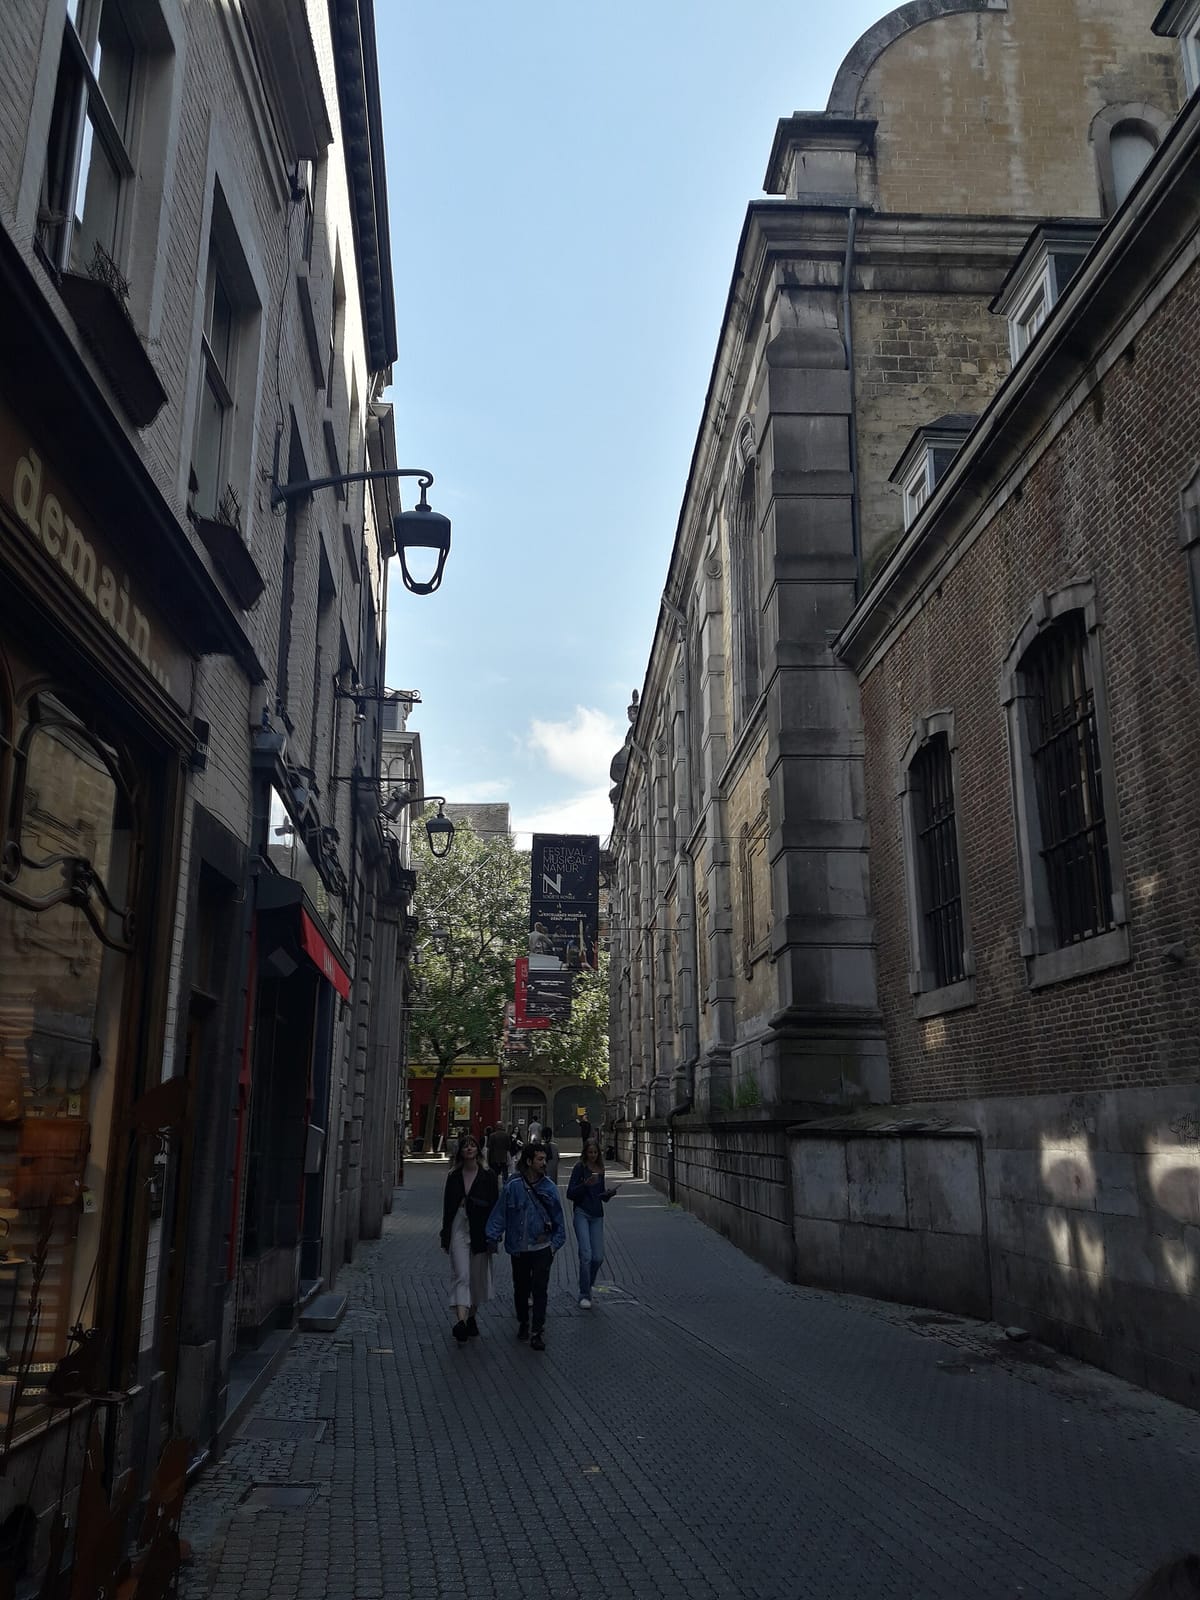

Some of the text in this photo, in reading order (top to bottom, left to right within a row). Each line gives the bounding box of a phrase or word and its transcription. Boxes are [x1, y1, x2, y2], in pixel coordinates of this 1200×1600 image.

[543, 847, 585, 856] FESTIVAL
[543, 855, 587, 865] MUSICAL
[543, 863, 579, 872] NAMUR
[543, 873, 562, 894] N
